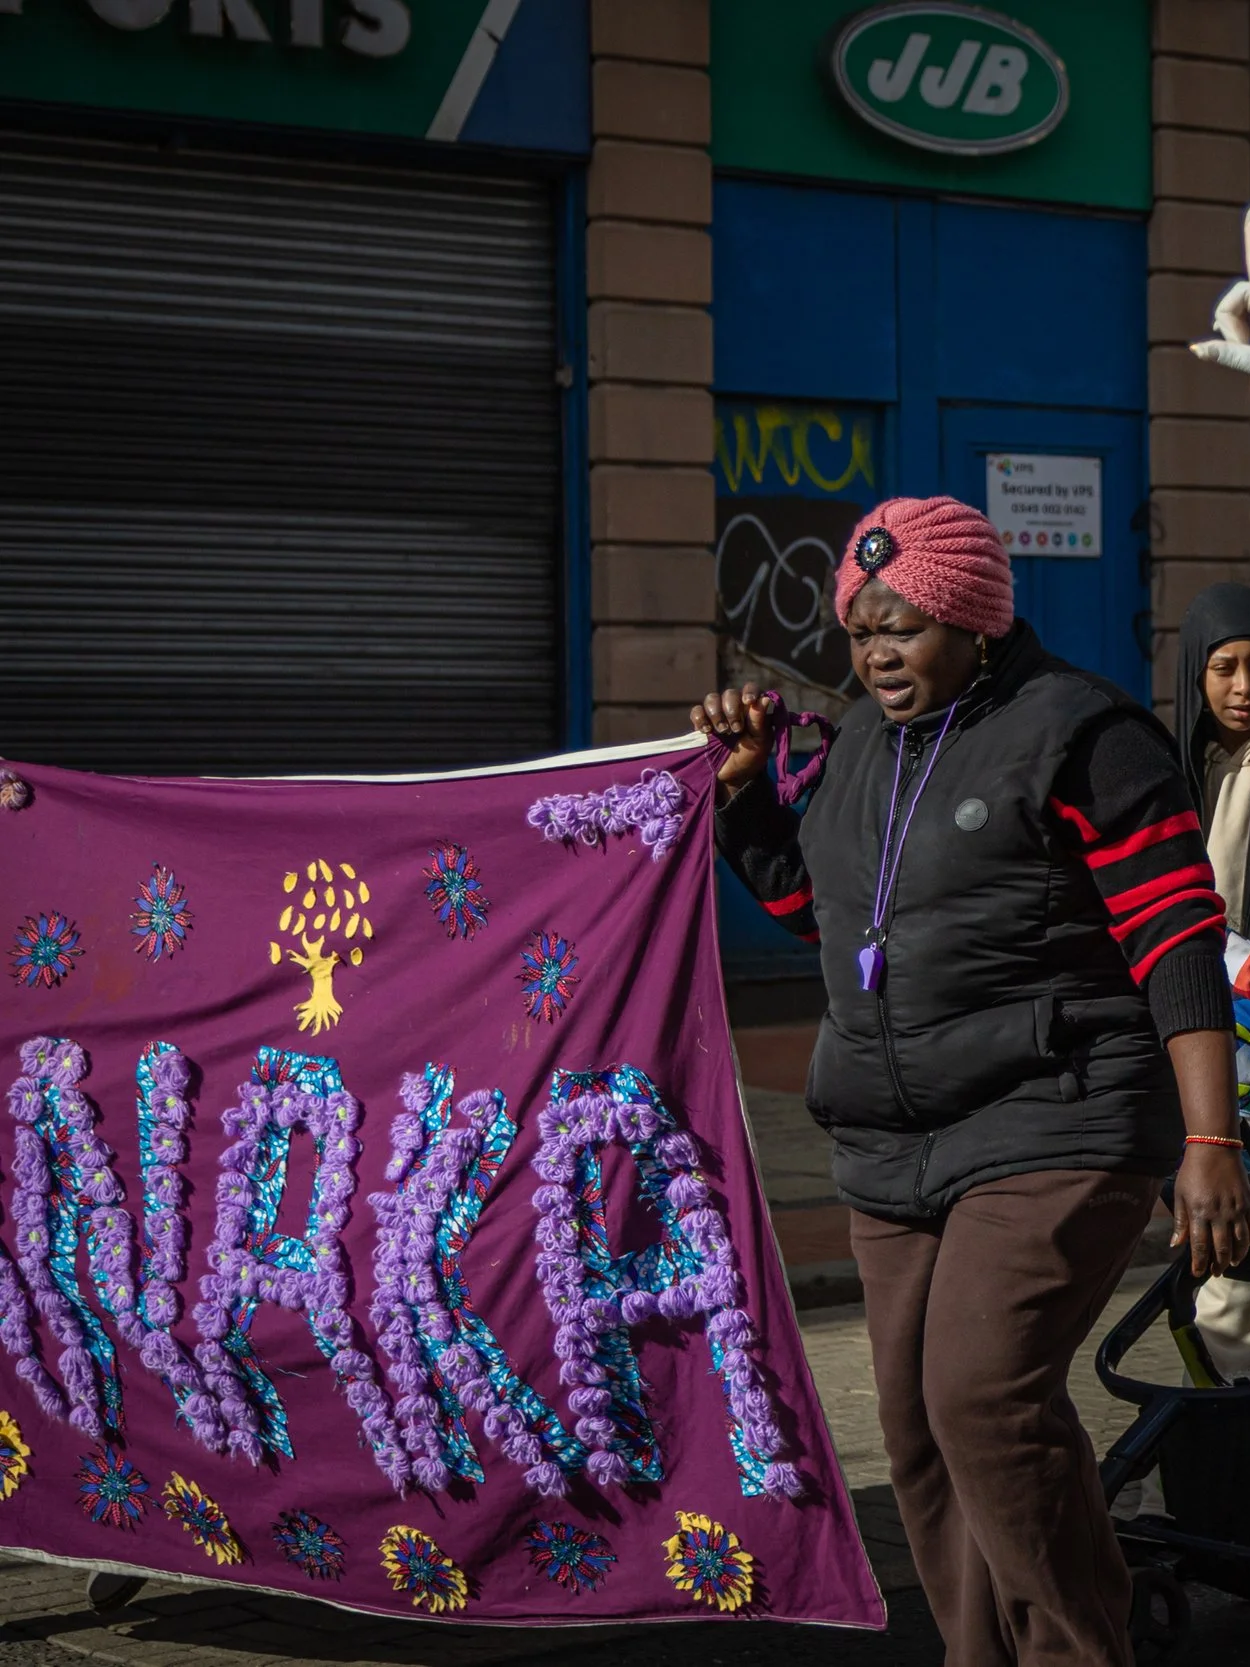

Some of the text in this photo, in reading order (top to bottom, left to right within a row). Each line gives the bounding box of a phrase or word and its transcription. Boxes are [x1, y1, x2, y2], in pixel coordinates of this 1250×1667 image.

[867, 32, 1030, 116] JJB
[1055, 485, 1069, 499] by
[0, 1034, 800, 1500] NAKA
